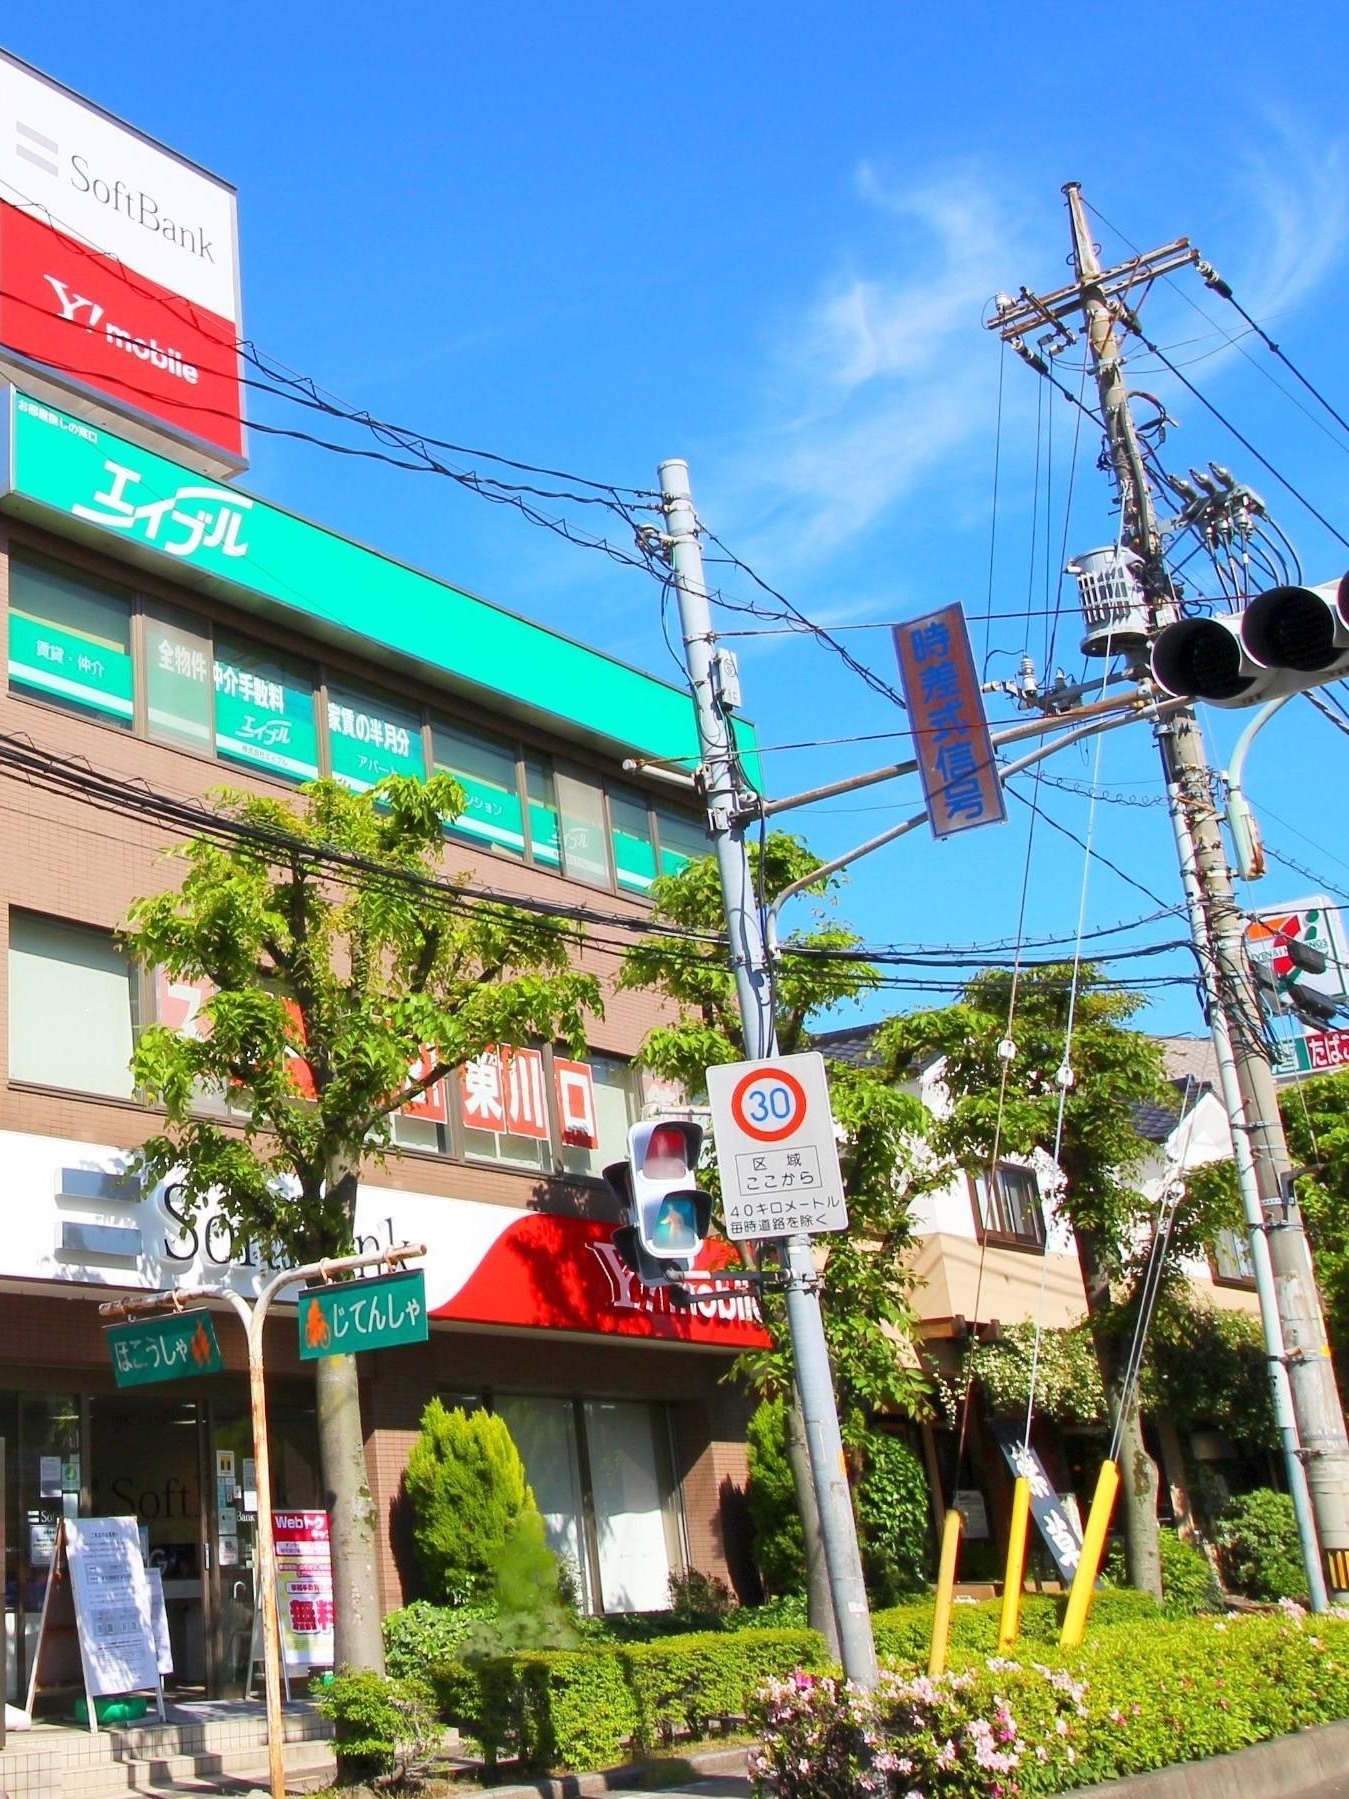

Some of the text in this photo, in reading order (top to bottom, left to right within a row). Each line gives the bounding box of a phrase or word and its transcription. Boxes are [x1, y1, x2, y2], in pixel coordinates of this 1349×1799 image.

[71, 156, 216, 264] SoftBank
[71, 459, 254, 556] エイブル
[158, 639, 207, 682] 全物件
[328, 702, 410, 757] 家賃の半月分
[234, 714, 293, 745] エイブル
[909, 620, 985, 820] 時差式信号
[463, 793, 503, 816] ンション
[749, 1087, 791, 1122] 30
[746, 1171, 814, 1190] ここから
[731, 1213, 828, 1234] 毎時道路を除く
[332, 1293, 421, 1338] じてんしゃ
[114, 1335, 188, 1373] ほこうしゃ
